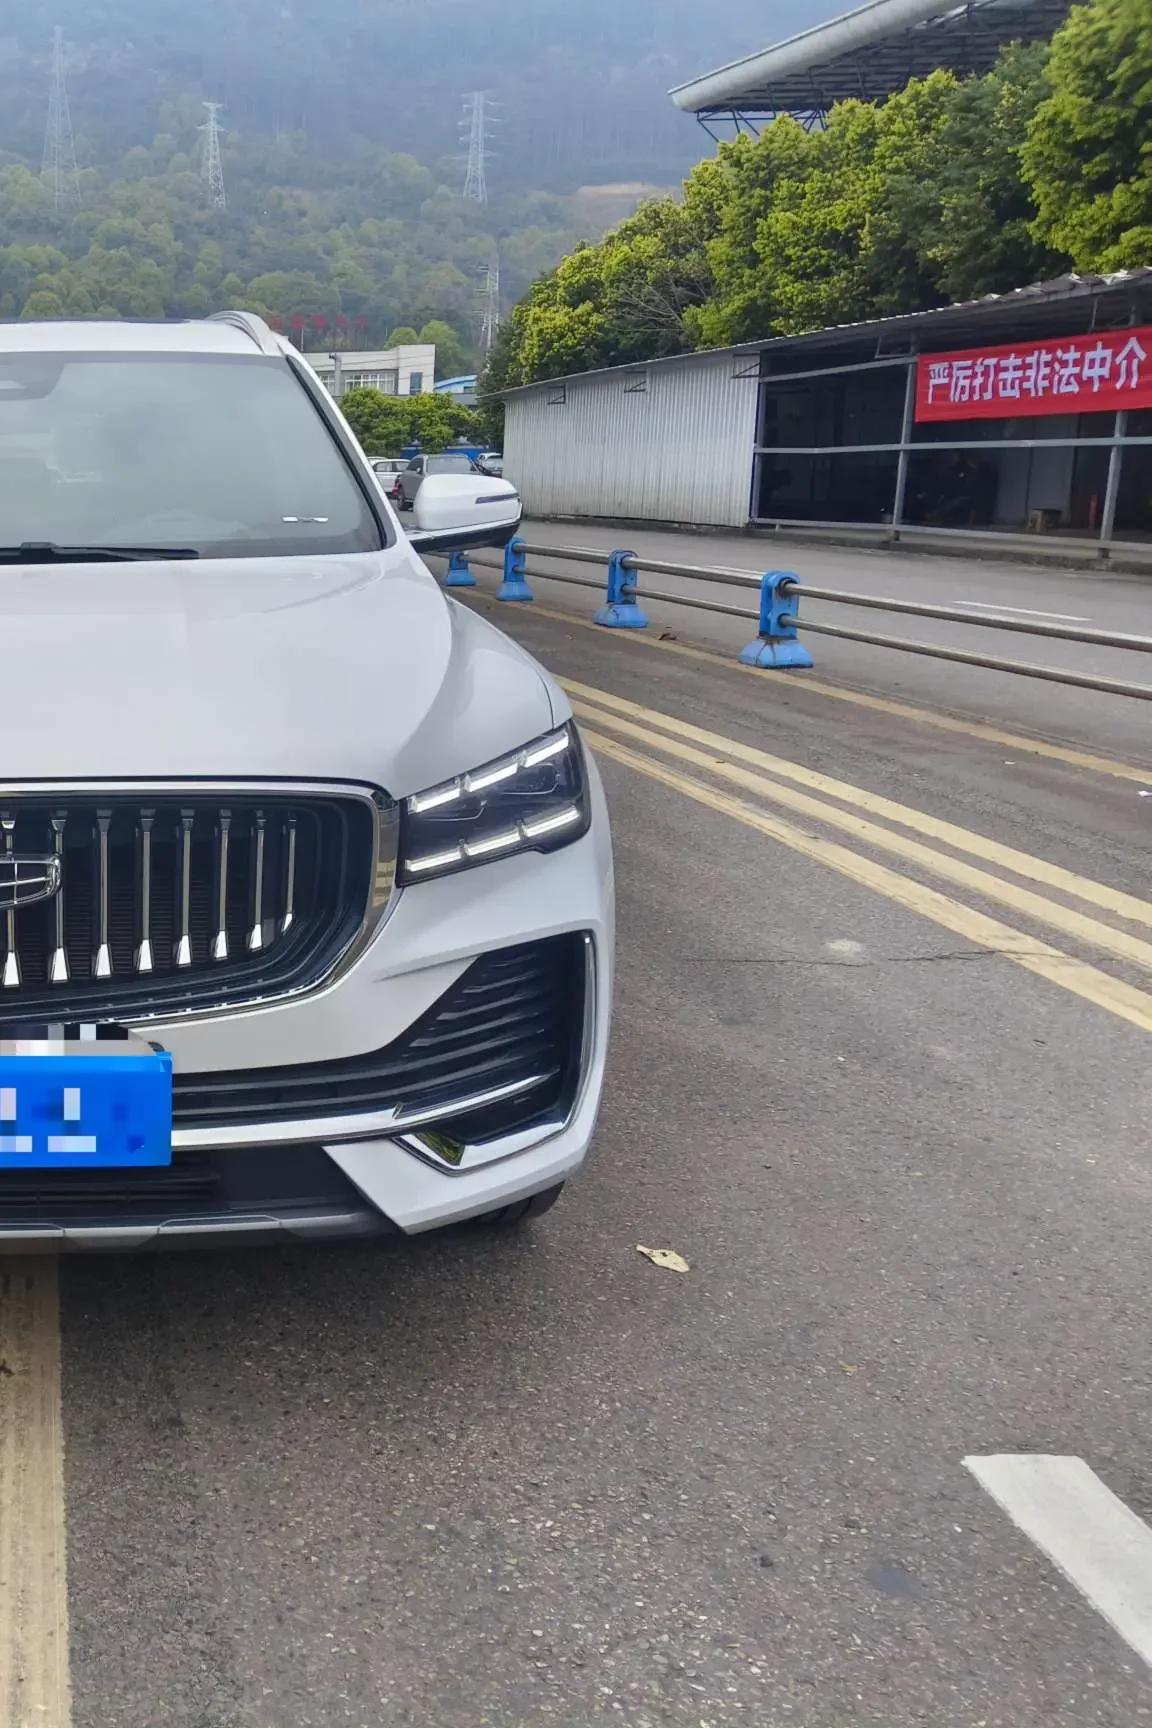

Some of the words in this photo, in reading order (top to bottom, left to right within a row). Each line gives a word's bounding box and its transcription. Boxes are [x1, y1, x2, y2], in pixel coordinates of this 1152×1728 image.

[928, 336, 1147, 404] 严厉打击非法中介
